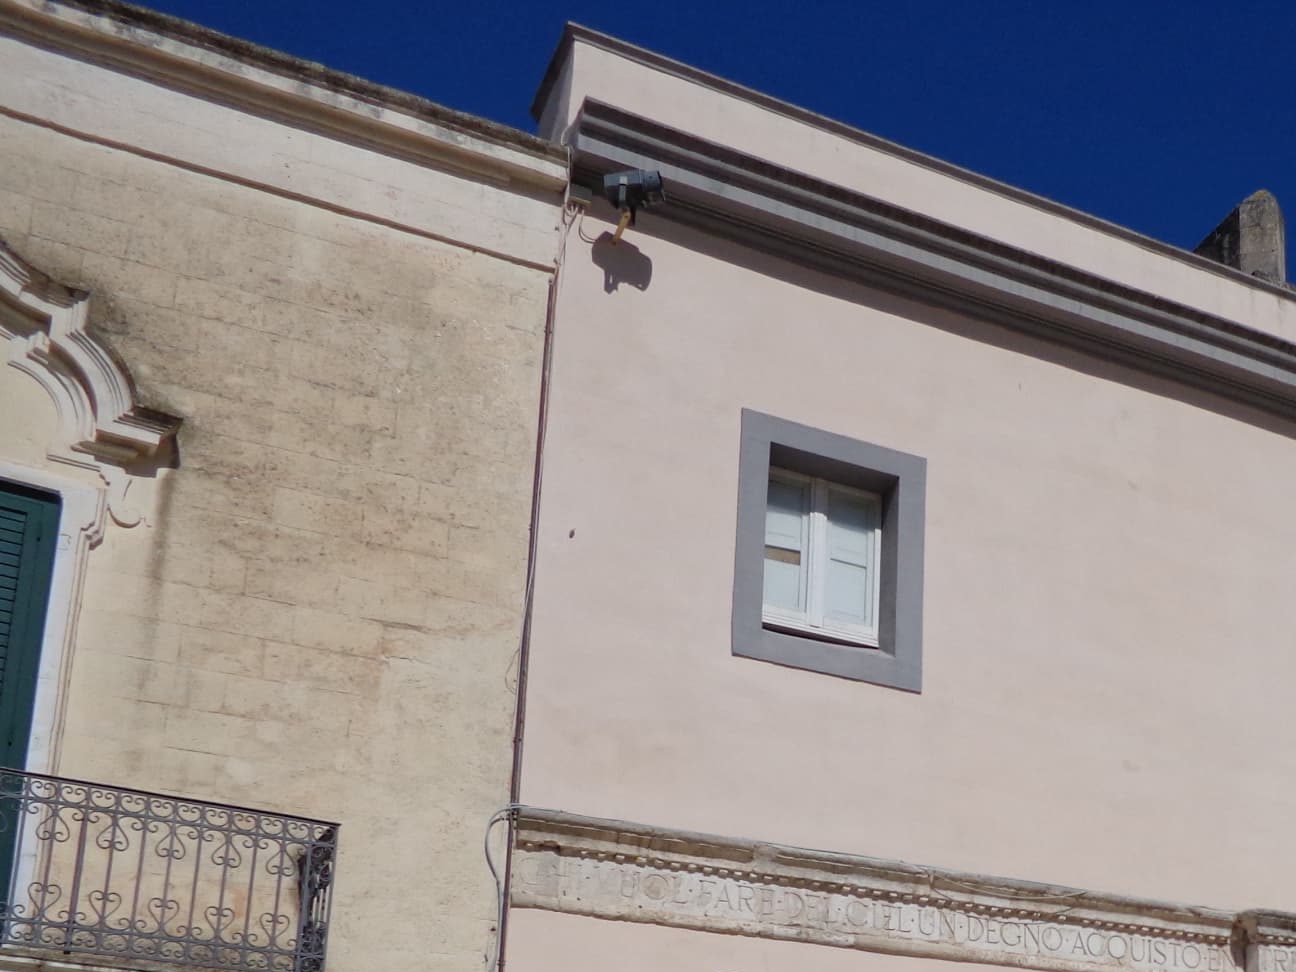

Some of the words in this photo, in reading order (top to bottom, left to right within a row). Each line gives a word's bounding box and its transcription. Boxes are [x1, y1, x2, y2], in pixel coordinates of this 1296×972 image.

[698, 879, 775, 916] FARE
[783, 890, 838, 924] DEL
[846, 900, 911, 933] CIEL
[917, 908, 956, 943] UN
[966, 914, 1064, 953] DEGNO
[1071, 931, 1202, 969] ACQUISTO
